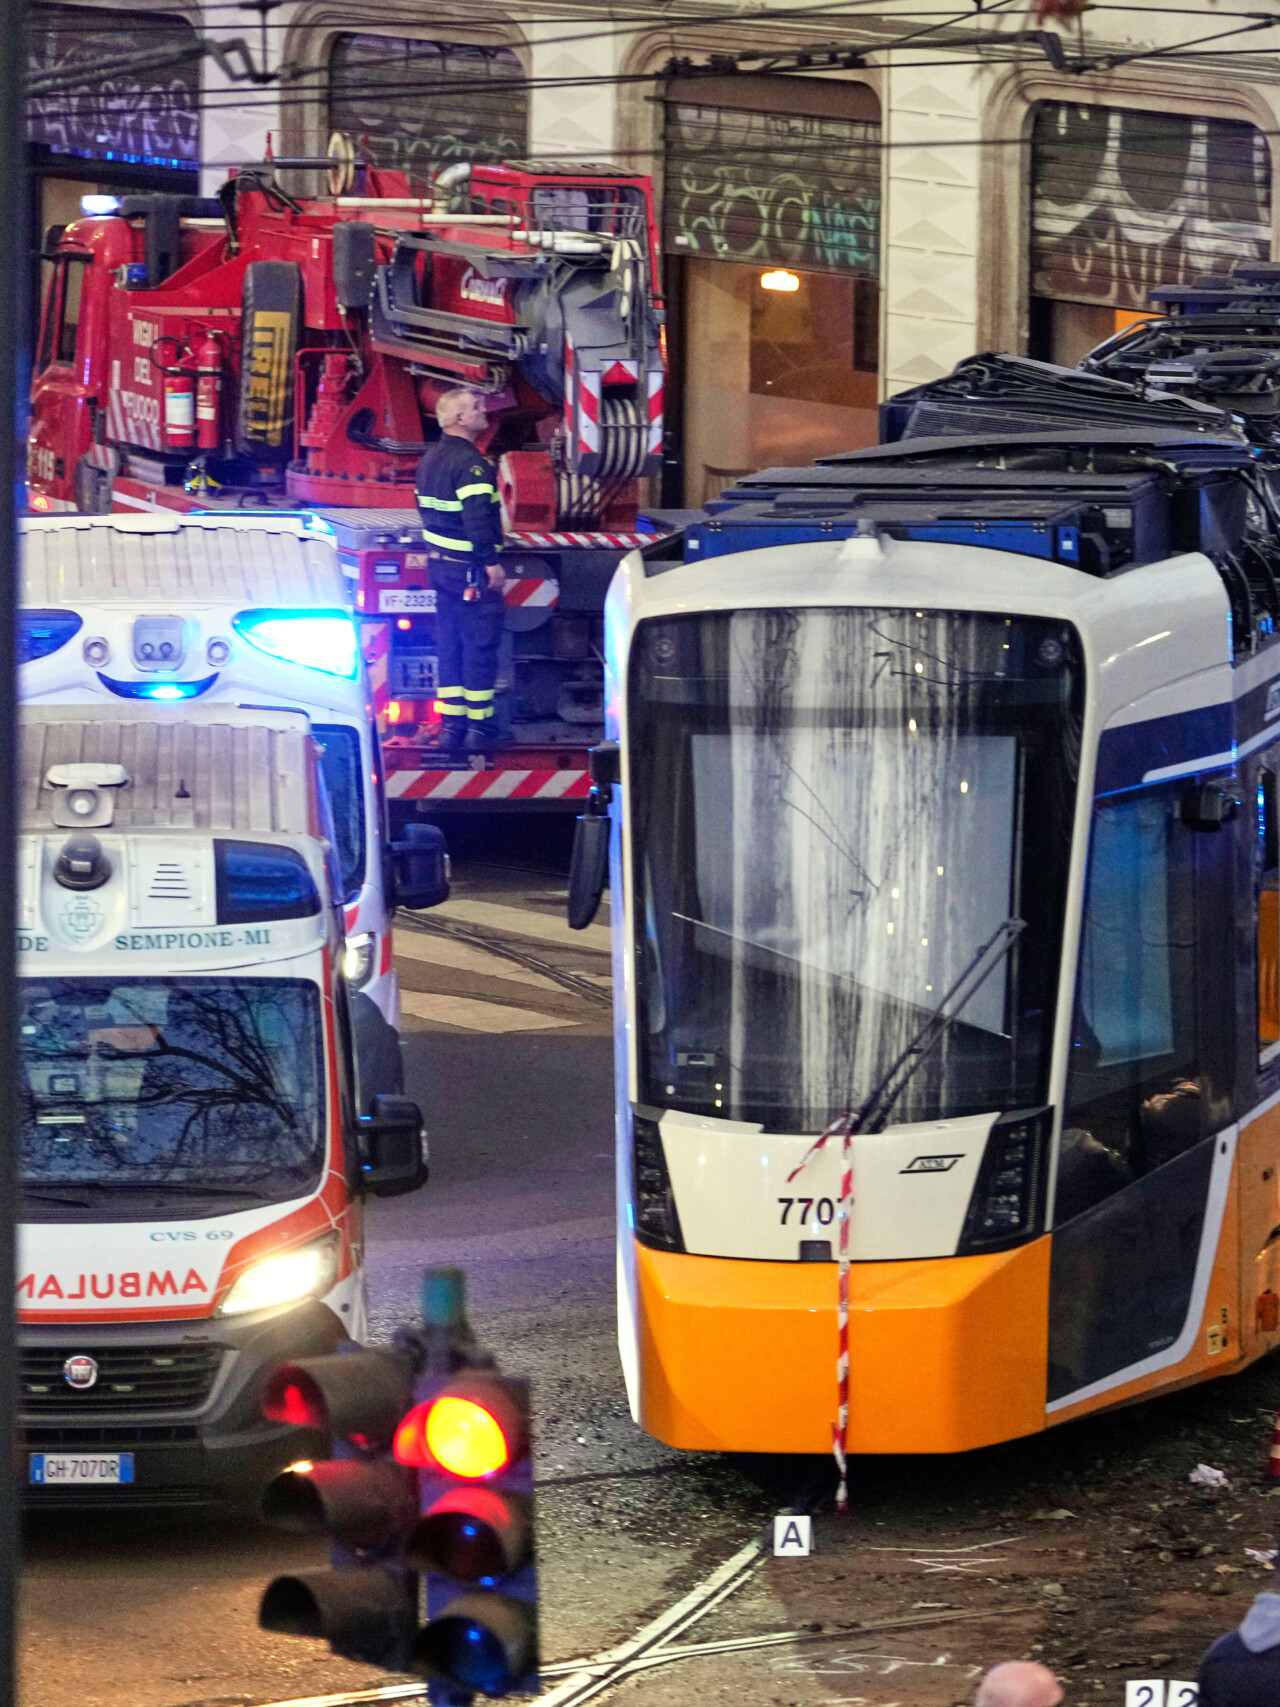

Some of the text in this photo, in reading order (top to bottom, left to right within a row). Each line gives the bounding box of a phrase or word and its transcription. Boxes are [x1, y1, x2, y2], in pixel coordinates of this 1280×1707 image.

[134, 356, 153, 386] DEL
[919, 1159, 945, 1169] ATM
[150, 1230, 234, 1242] CVS 69
[780, 1521, 804, 1548] A
